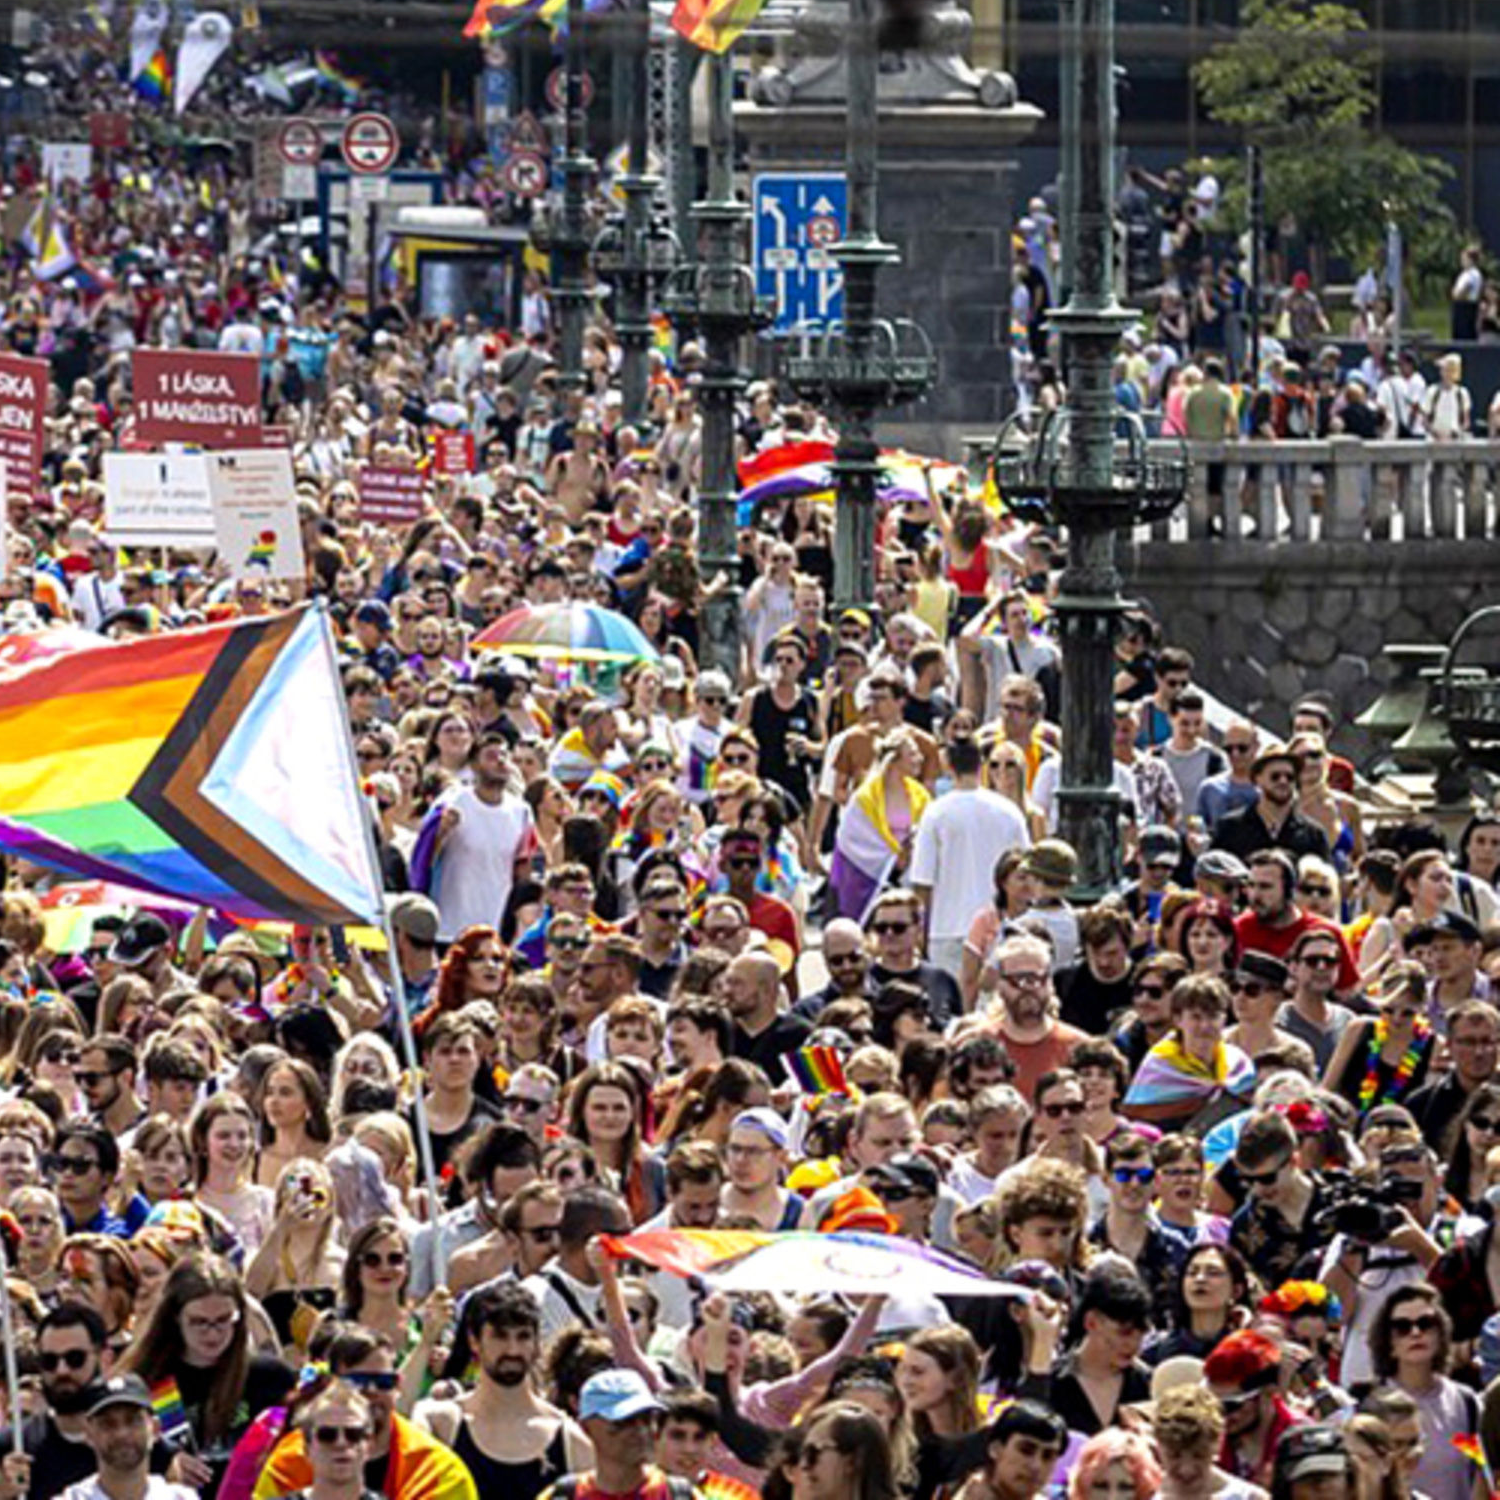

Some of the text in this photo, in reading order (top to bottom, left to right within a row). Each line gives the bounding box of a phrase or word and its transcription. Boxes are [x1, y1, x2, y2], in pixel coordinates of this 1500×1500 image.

[157, 372, 169, 394] 1
[138, 399, 259, 426] 1 MANŽELSTVÍ
